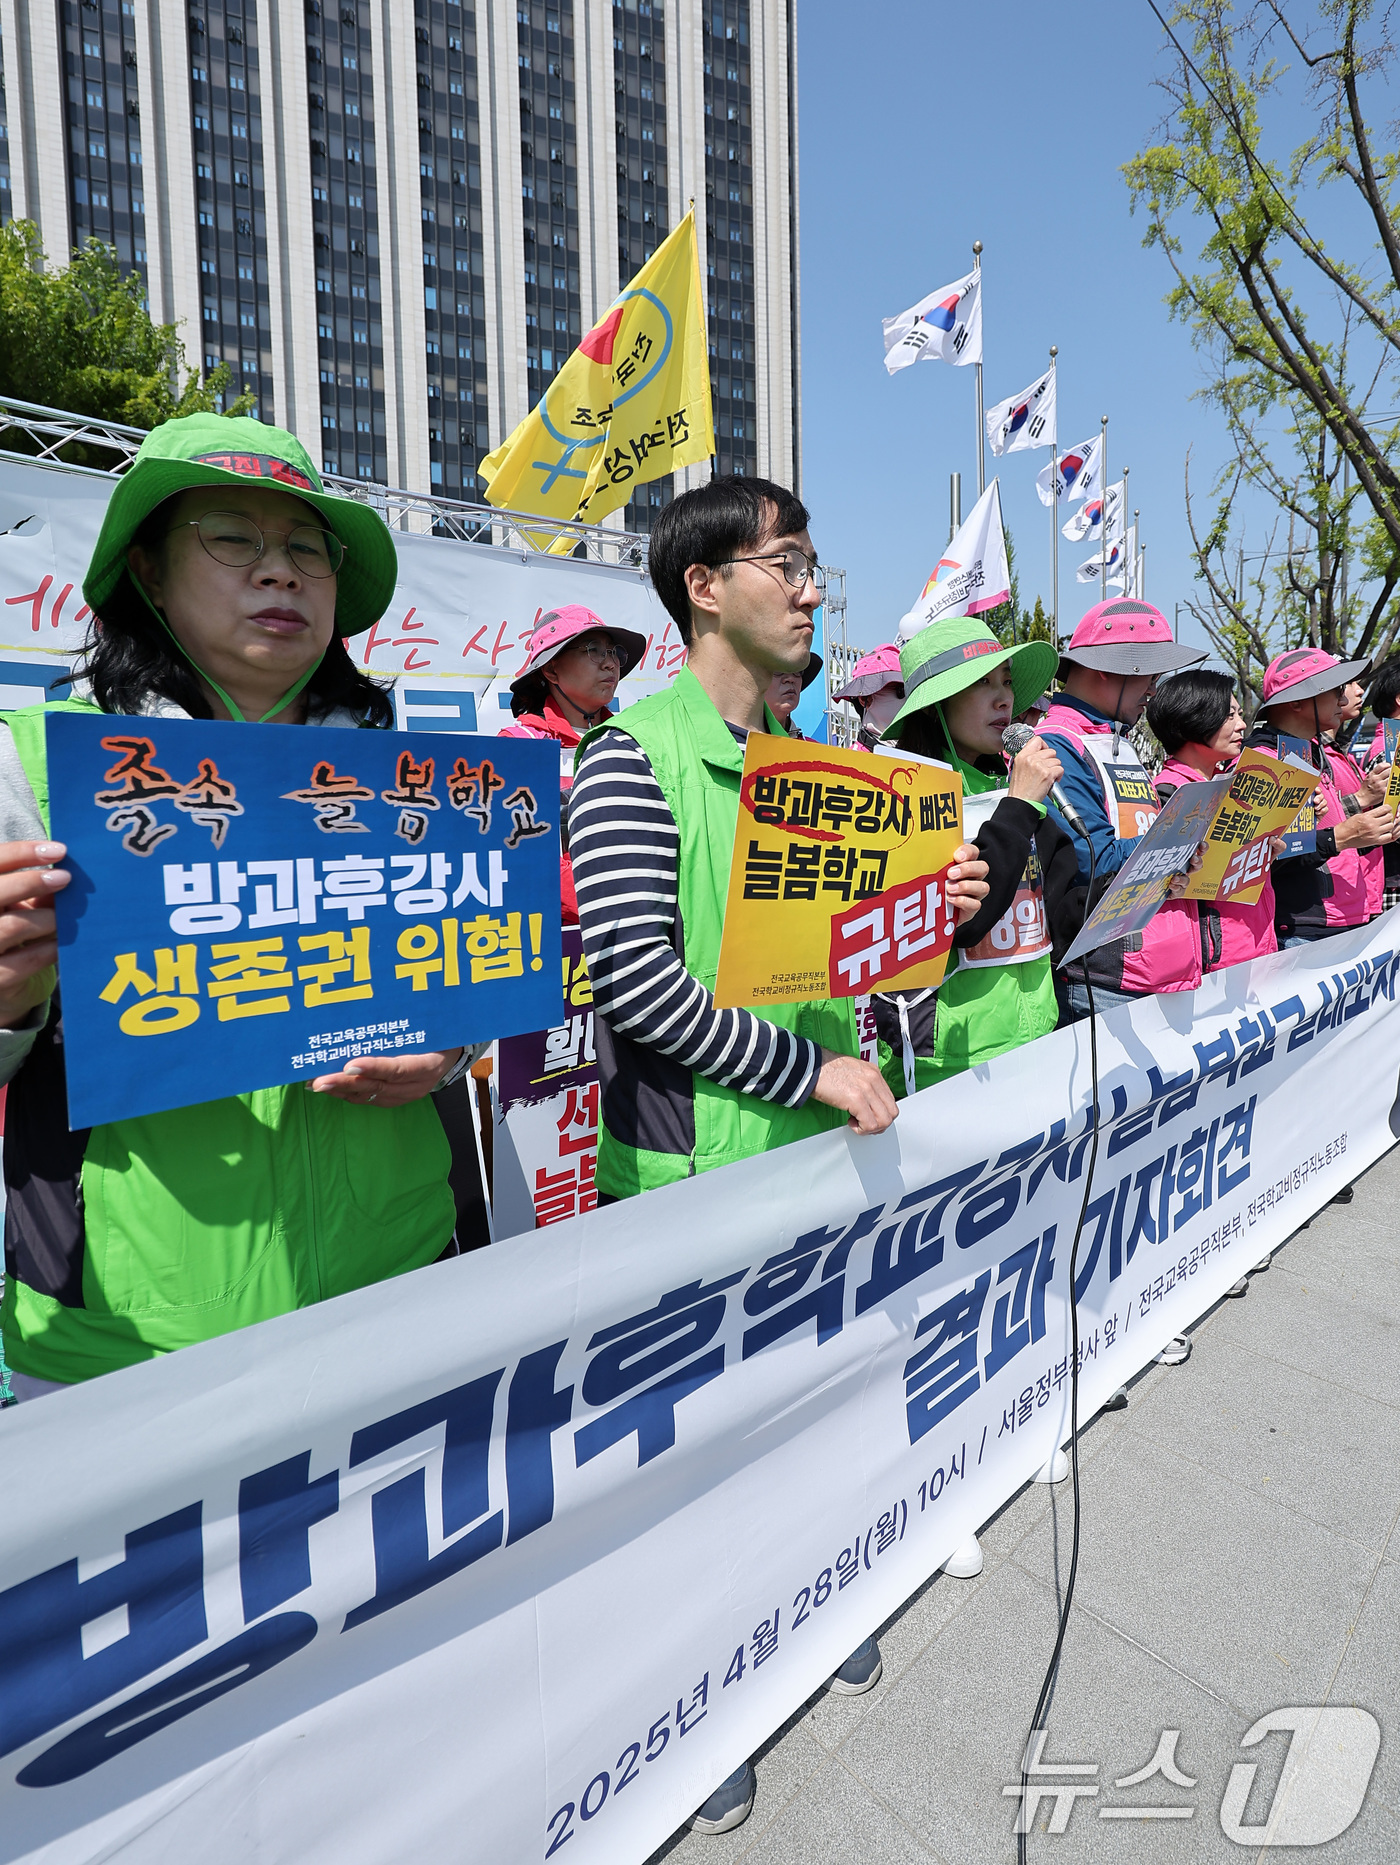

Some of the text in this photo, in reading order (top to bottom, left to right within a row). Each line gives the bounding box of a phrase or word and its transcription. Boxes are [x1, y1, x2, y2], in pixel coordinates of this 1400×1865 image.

[94, 736, 552, 857] 졸속 늘봄학교
[753, 775, 959, 837] 방과후강사 빠진
[1115, 780, 1149, 800] 대표자
[1229, 771, 1310, 809] 방과후강사 빠진
[1209, 806, 1262, 846] 늘봄학교
[163, 849, 509, 936] 방과후강사
[742, 839, 889, 902] 늘봄학교
[1221, 835, 1279, 896] 규탄!
[836, 878, 956, 988] 규탄!
[98, 925, 375, 1038] 생존권
[394, 911, 544, 993] 위협!
[751, 981, 827, 998] 전국학교비정규직노동조합
[770, 970, 826, 984] 전국교육공무직본부
[290, 1029, 427, 1070] 전국학교비정규직노동조합
[307, 1018, 411, 1050] 전국교육공무직본부
[902, 1093, 1258, 1446] 결과 기자회견
[544, 1670, 710, 1861] 2025년
[722, 1607, 781, 1690] 4월
[791, 1497, 909, 1632] 28일(월)
[916, 1441, 967, 1513] 10시
[1104, 1312, 1119, 1350] 앞
[1138, 1211, 1245, 1318] 전국교육공무직본부,
[1246, 1130, 1348, 1228] 전국학교비정규직노동조합
